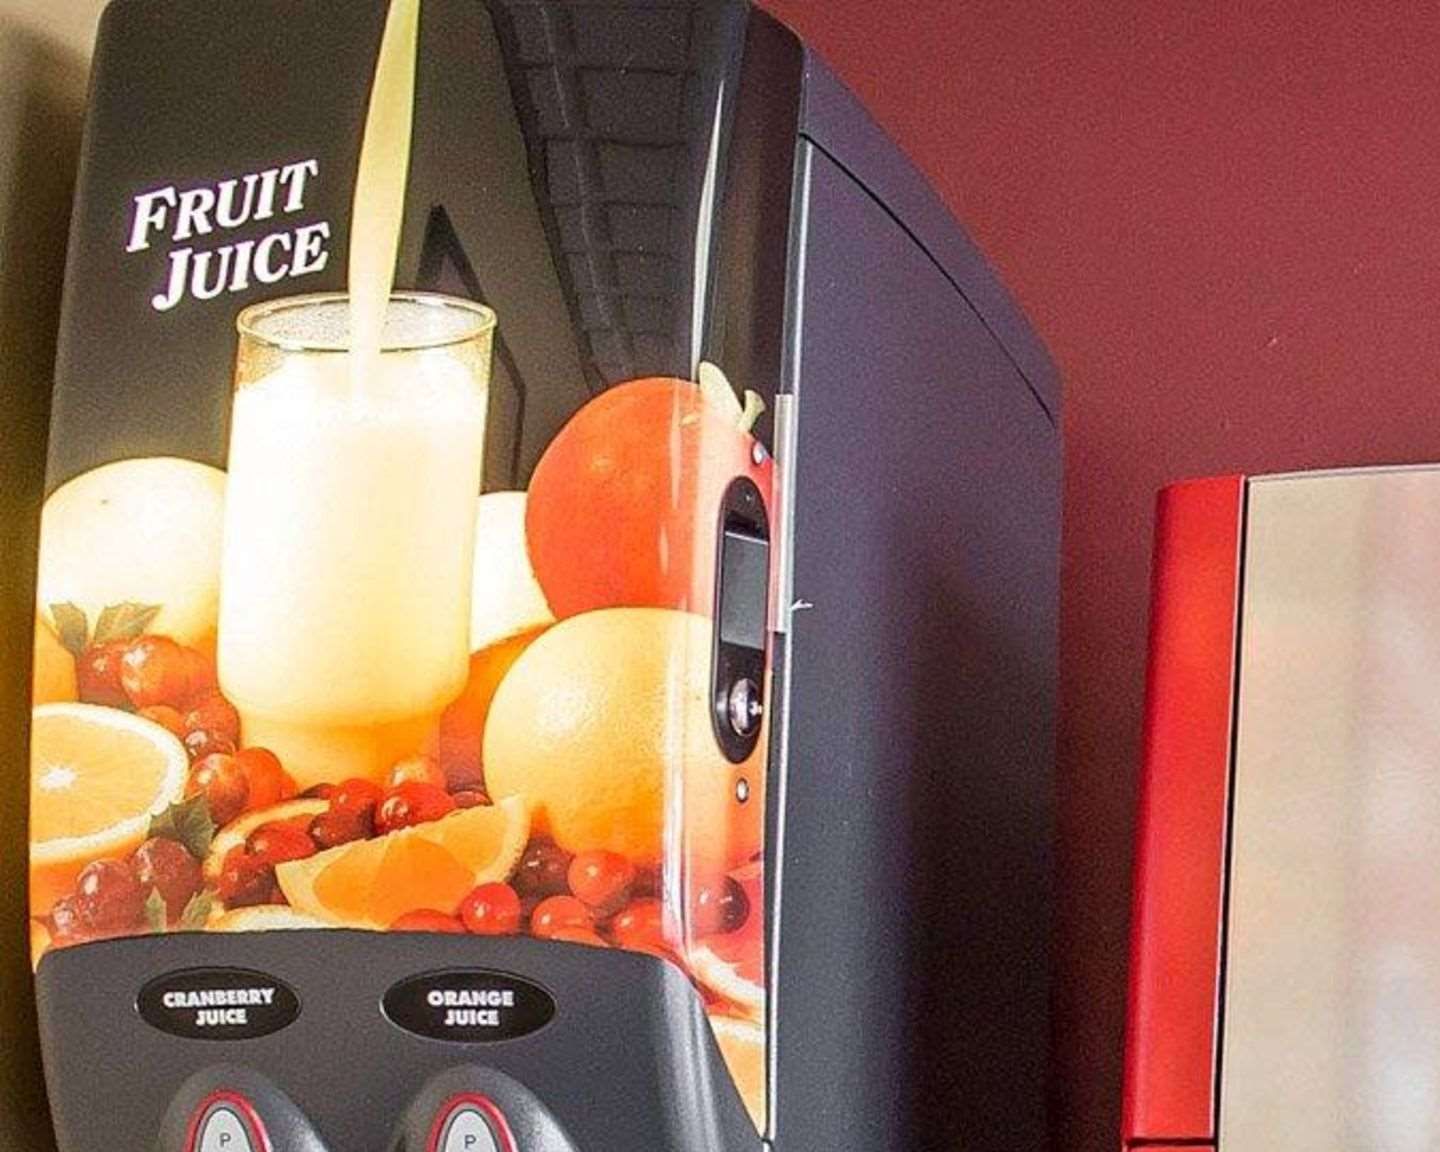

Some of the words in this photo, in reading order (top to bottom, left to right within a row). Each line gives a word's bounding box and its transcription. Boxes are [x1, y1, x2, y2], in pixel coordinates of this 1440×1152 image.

[126, 159, 319, 253] FRUIT
[151, 221, 330, 312] JUICE
[163, 987, 275, 1008] CRANBERRY
[427, 989, 515, 1006] ORANGE
[195, 1008, 248, 1026] JUICE
[444, 1009, 500, 1026] JUICE
